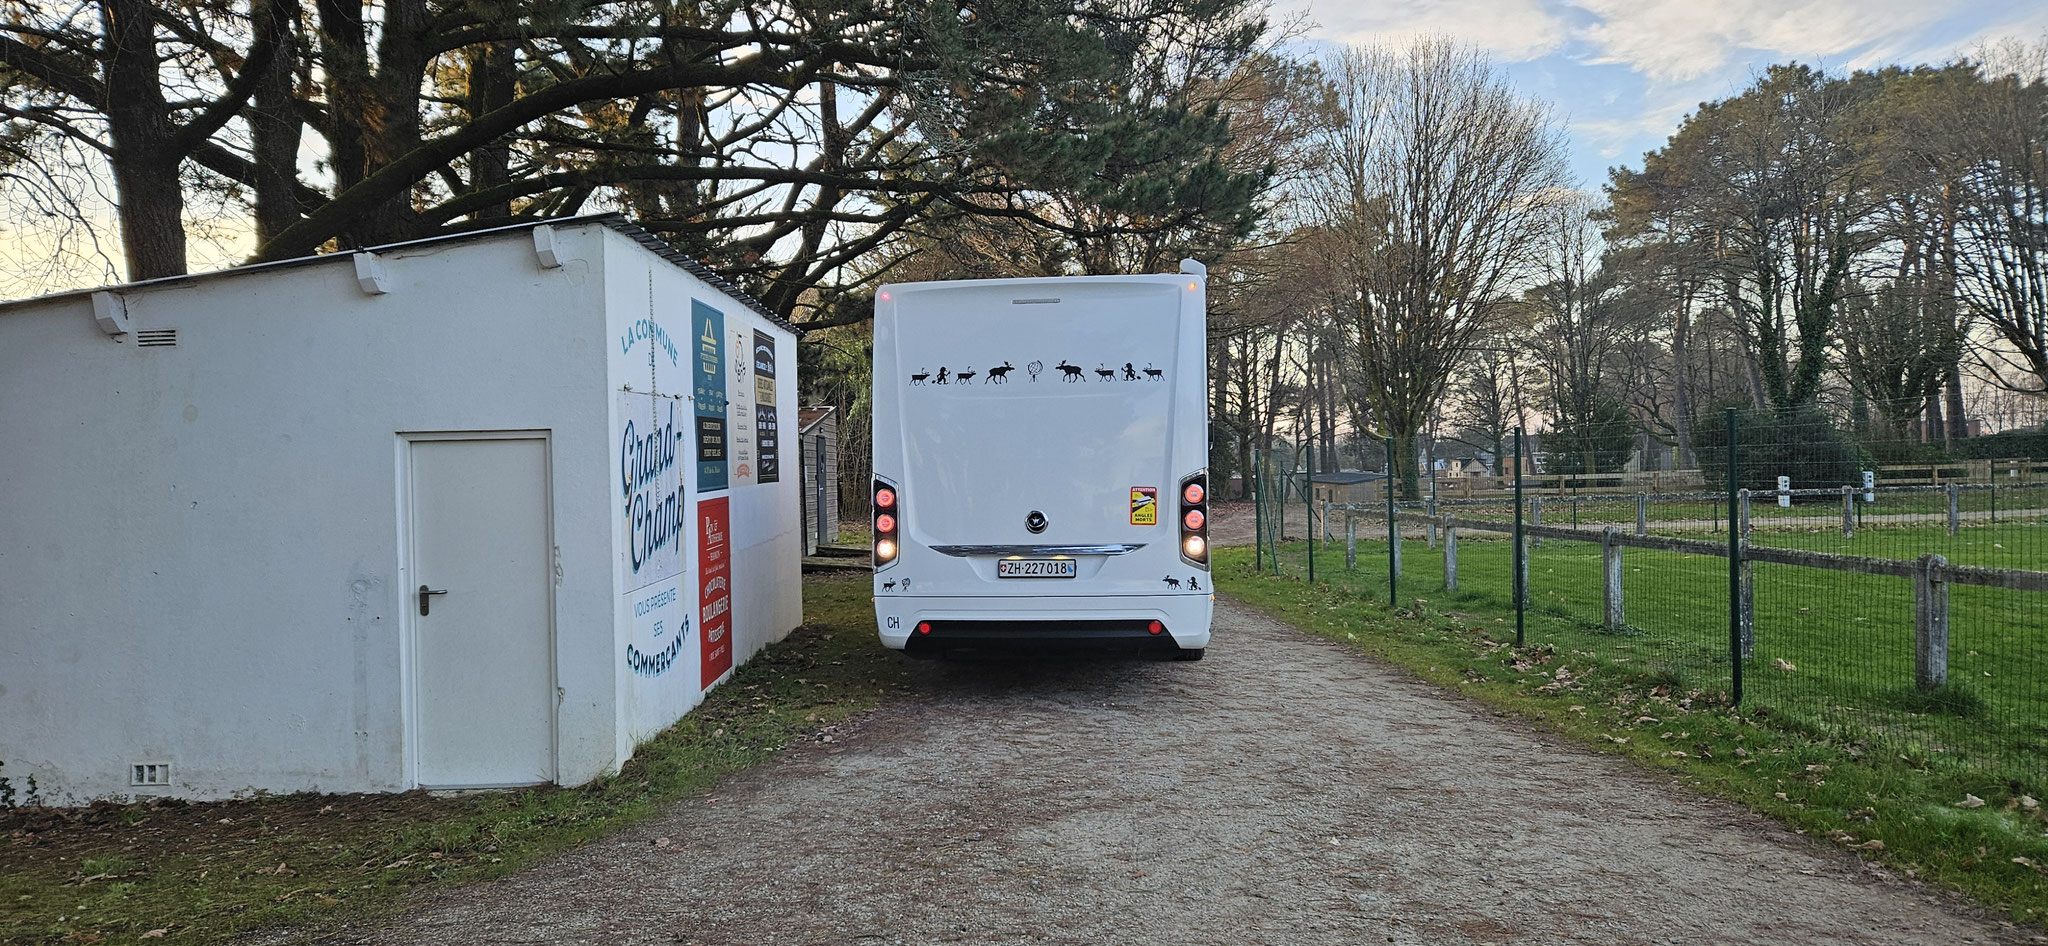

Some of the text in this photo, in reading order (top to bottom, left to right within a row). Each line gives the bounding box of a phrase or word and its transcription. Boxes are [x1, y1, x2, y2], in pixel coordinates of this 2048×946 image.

[621, 326, 635, 355] LA
[631, 484, 685, 574] Champ
[633, 587, 677, 618] VOUS PRÉSENTE
[702, 594, 729, 624] BOULANGERIE
[653, 620, 664, 637] SES
[887, 616, 900, 629] CH
[626, 613, 690, 678] COMMERÇANTS
